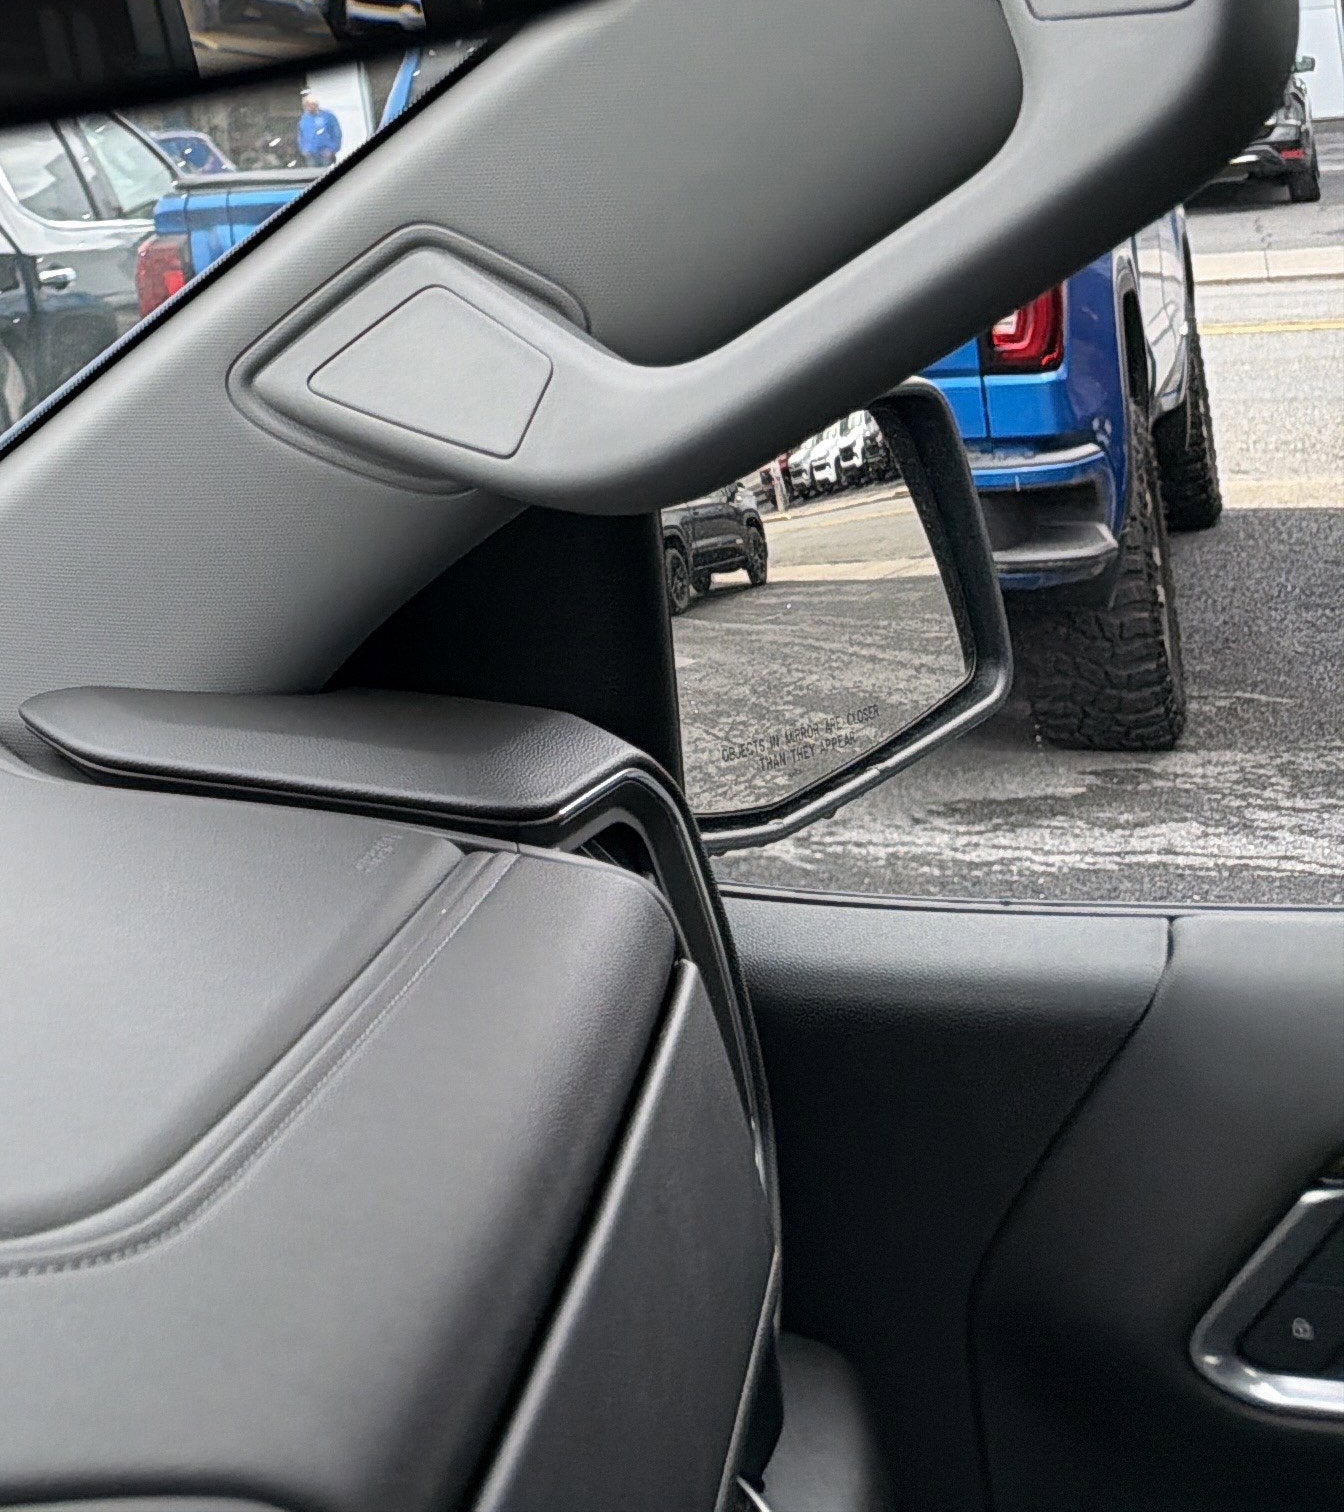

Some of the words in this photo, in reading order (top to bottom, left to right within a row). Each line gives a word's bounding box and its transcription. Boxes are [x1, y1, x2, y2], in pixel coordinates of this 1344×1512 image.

[721, 738, 766, 763] OBJECTS
[769, 733, 780, 749] IN
[785, 723, 820, 744] MIRROR
[825, 715, 844, 734] ARE
[846, 704, 880, 726] CLOSER
[759, 751, 787, 772] THAN
[790, 742, 816, 764] THEY
[820, 731, 857, 755] APPEAR
